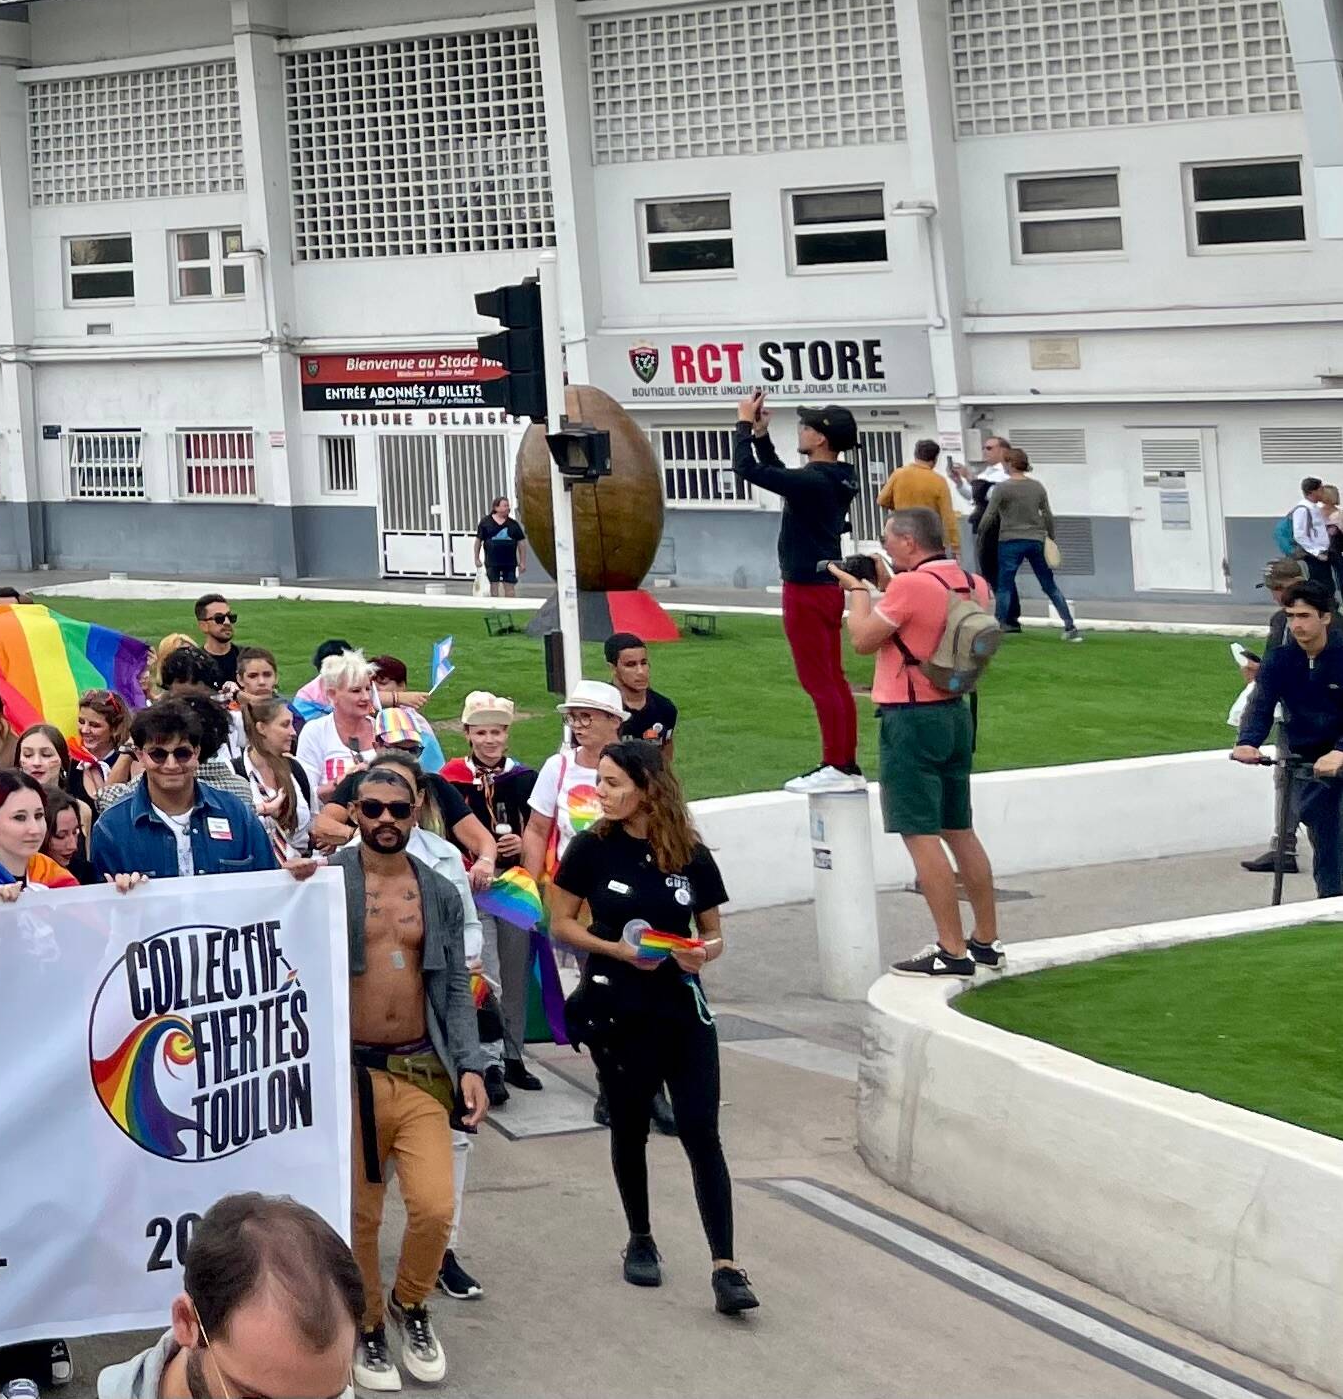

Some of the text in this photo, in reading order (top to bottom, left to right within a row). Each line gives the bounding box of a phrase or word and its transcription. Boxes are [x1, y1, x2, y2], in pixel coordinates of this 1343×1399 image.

[346, 357, 417, 371] Bienvenue
[418, 358, 436, 369] au
[439, 354, 479, 368] Stade
[671, 339, 885, 384] RCT STORE
[325, 385, 367, 400] ENTRÉE
[369, 383, 426, 399] ABONNÉS
[438, 384, 483, 398] BILLETS
[632, 385, 676, 397] BOUTIQUE
[678, 384, 718, 396] OUVERTE
[782, 383, 802, 394] LES
[803, 383, 834, 394] JOURS
[837, 382, 849, 394] DE
[852, 381, 887, 393] MATCH
[341, 411, 521, 426] TRIBUNE DELANGRE
[125, 920, 283, 1021] COLLECTIF
[191, 1063, 313, 1160] TOULON
[144, 1212, 202, 1274] 20
